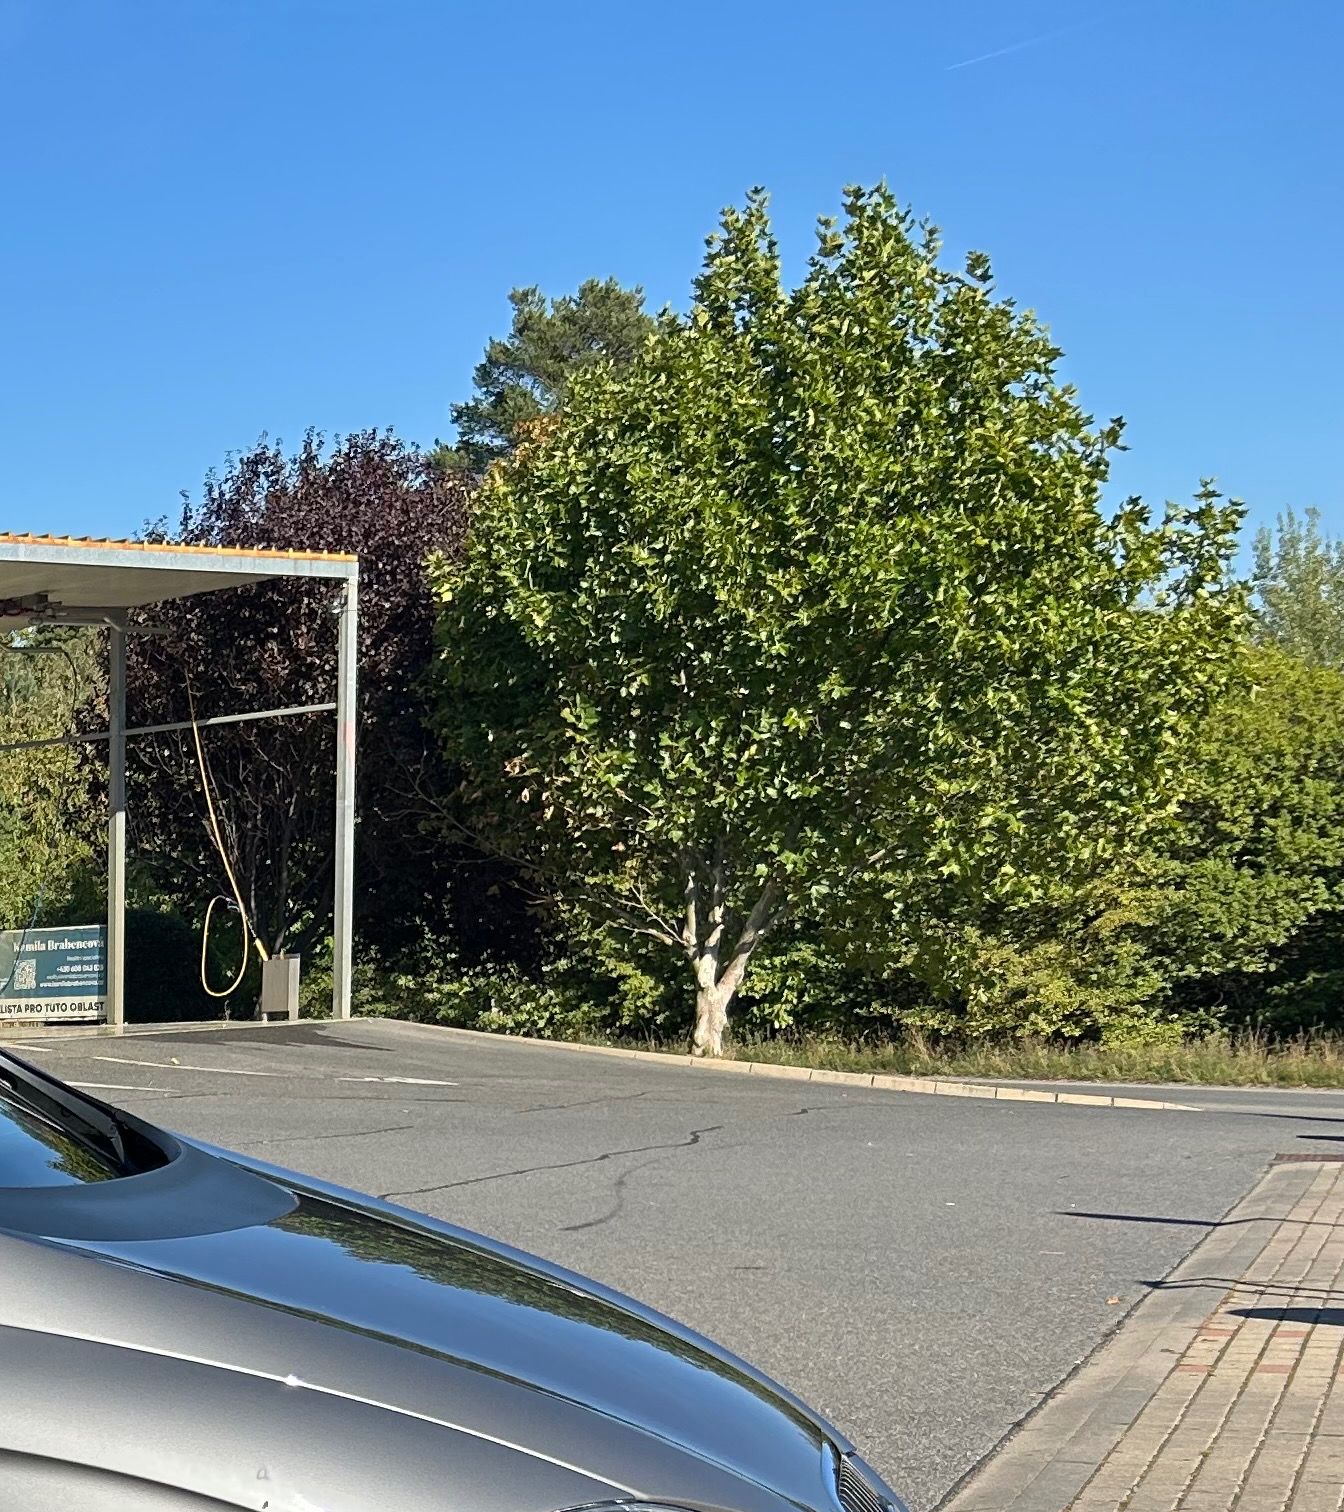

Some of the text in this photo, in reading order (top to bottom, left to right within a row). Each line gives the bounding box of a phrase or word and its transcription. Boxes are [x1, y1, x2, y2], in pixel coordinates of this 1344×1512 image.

[24, 1003, 43, 1013] PRO
[45, 1003, 68, 1013] TUTO
[70, 1002, 105, 1012] OBLAST
